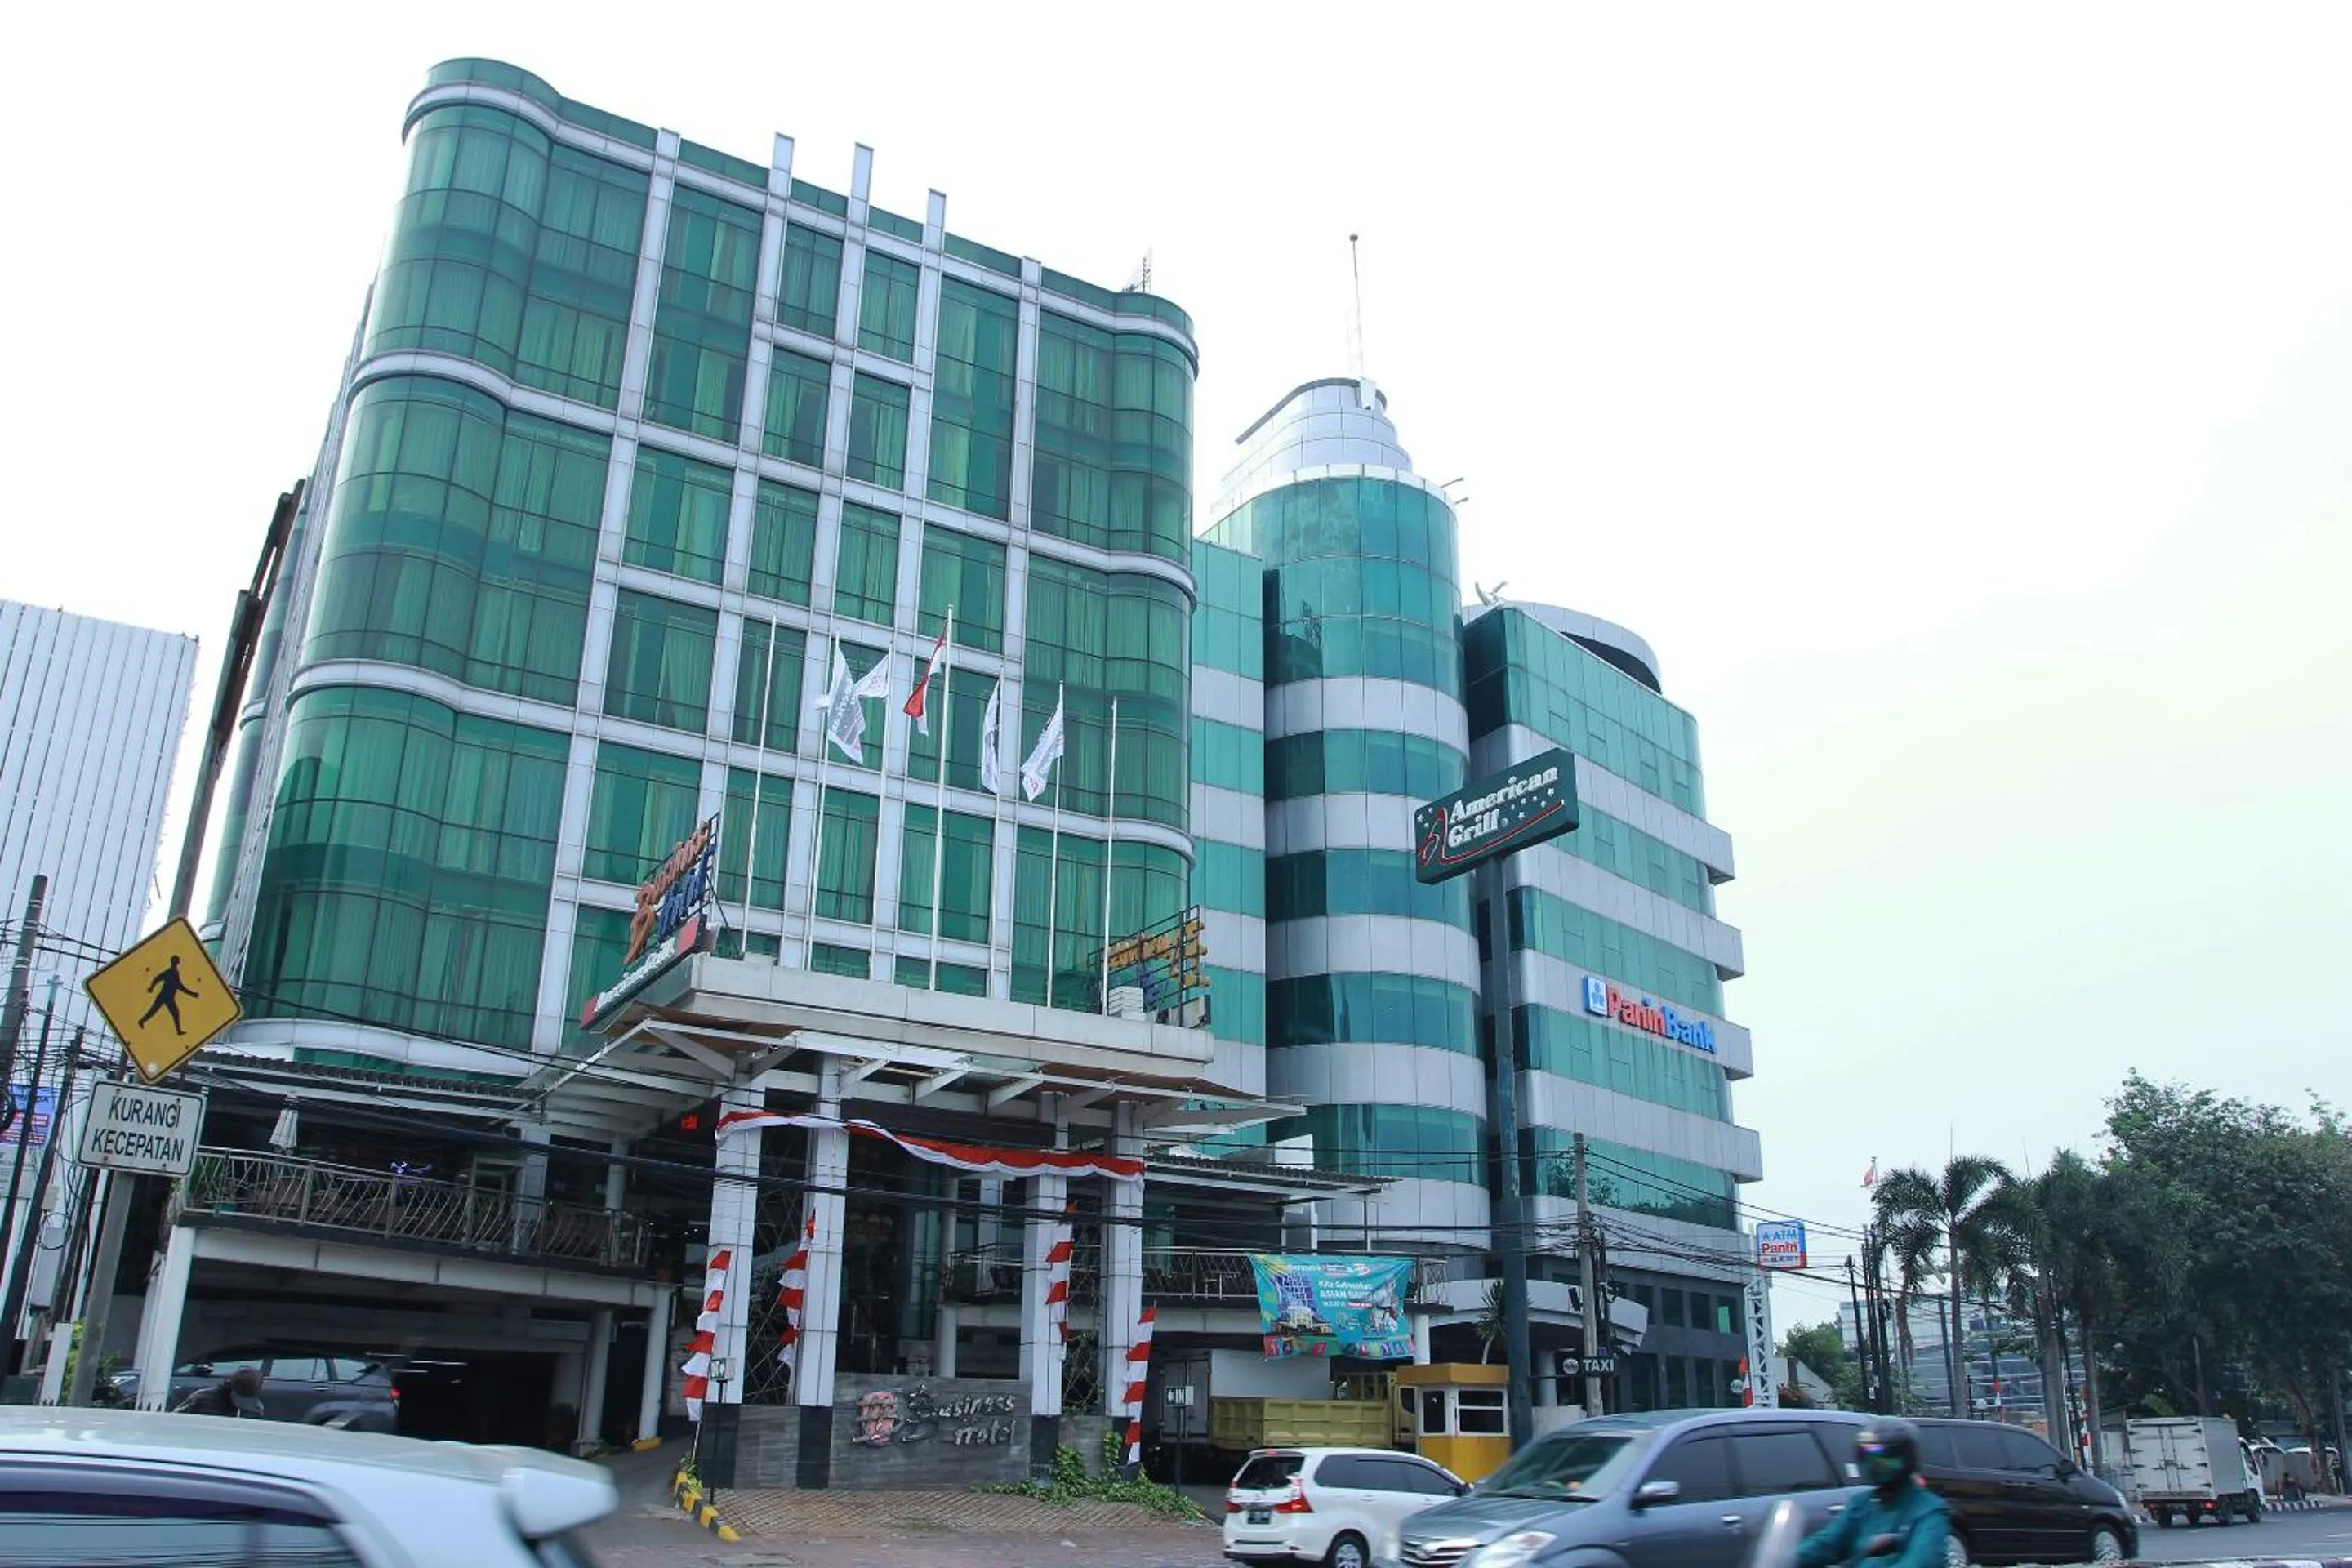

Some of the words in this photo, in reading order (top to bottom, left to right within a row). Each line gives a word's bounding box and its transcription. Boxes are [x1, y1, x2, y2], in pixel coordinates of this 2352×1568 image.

[1448, 766, 1559, 826] American
[1448, 808, 1500, 849] Grill
[108, 1095, 182, 1129] KURANGI
[91, 1129, 185, 1162] KECEPATAN
[1583, 1359, 1615, 1372] TAXI
[1175, 1388, 1185, 1404] IN
